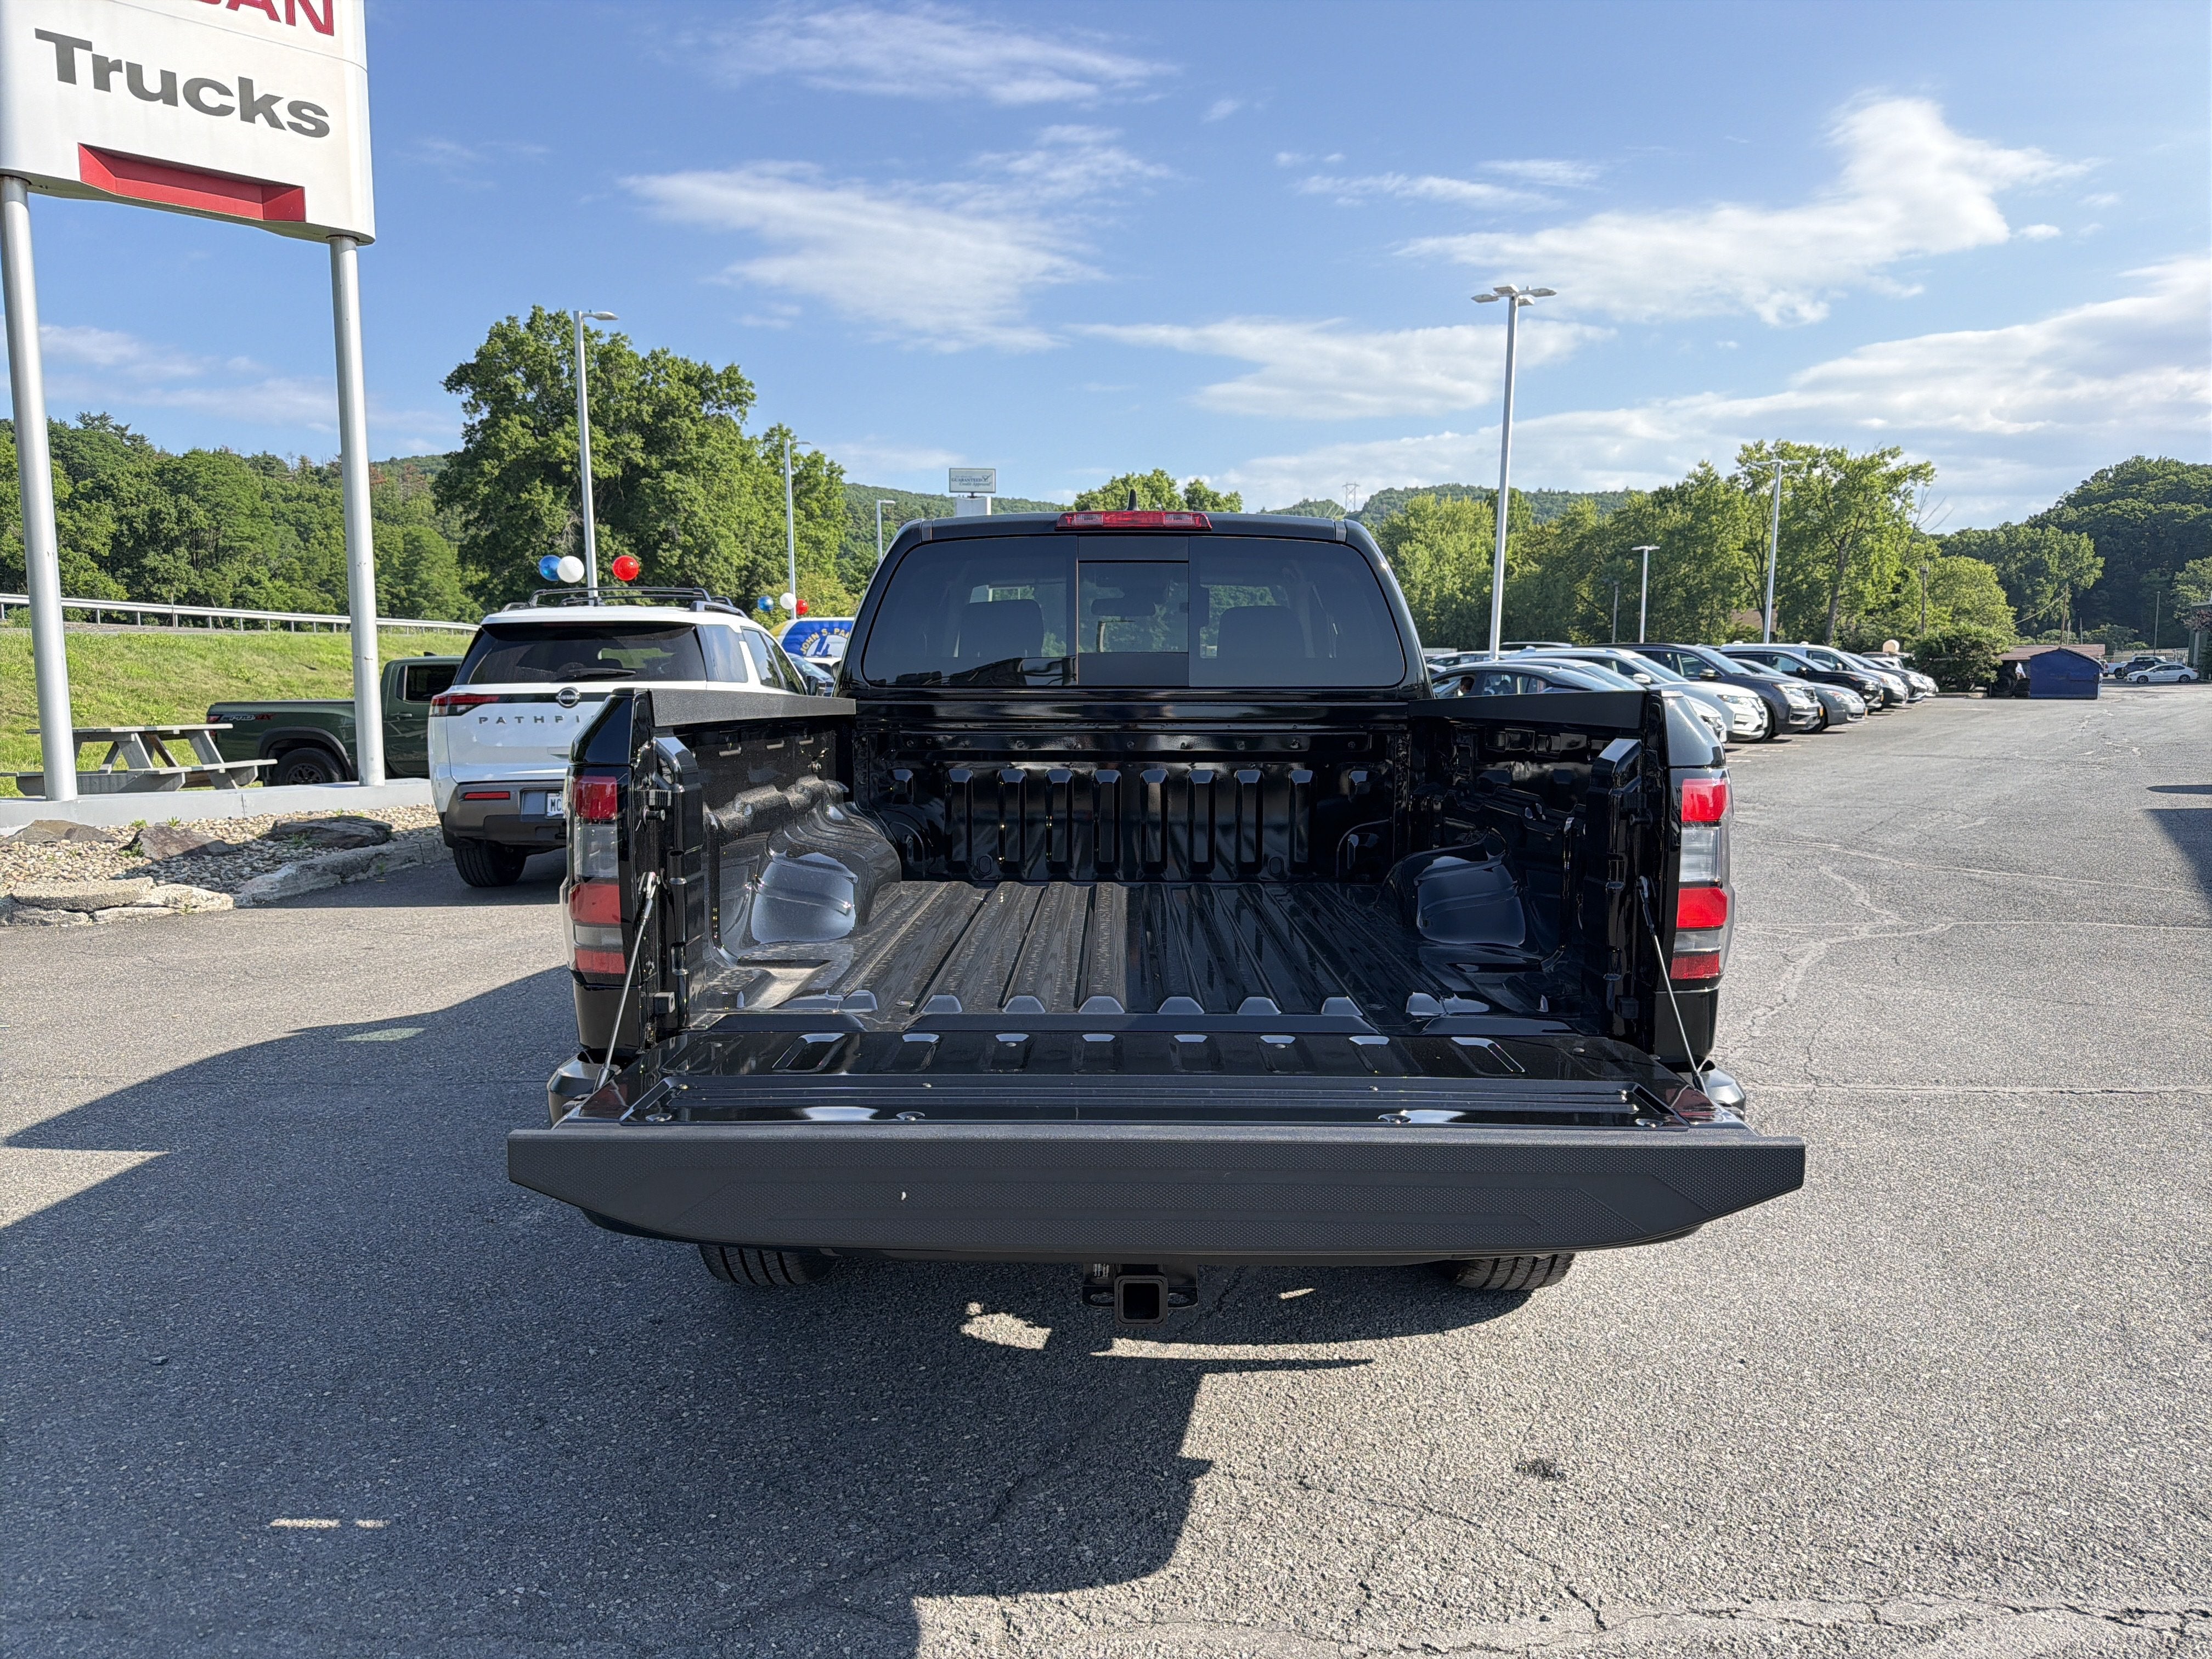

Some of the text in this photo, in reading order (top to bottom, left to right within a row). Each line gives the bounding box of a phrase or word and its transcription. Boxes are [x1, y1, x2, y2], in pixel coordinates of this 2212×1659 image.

[35, 28, 330, 138] Trucks
[800, 633, 820, 655] JOHN
[821, 628, 831, 636] S.
[479, 715, 594, 724] PATHFI
[550, 798, 562, 812] MC
